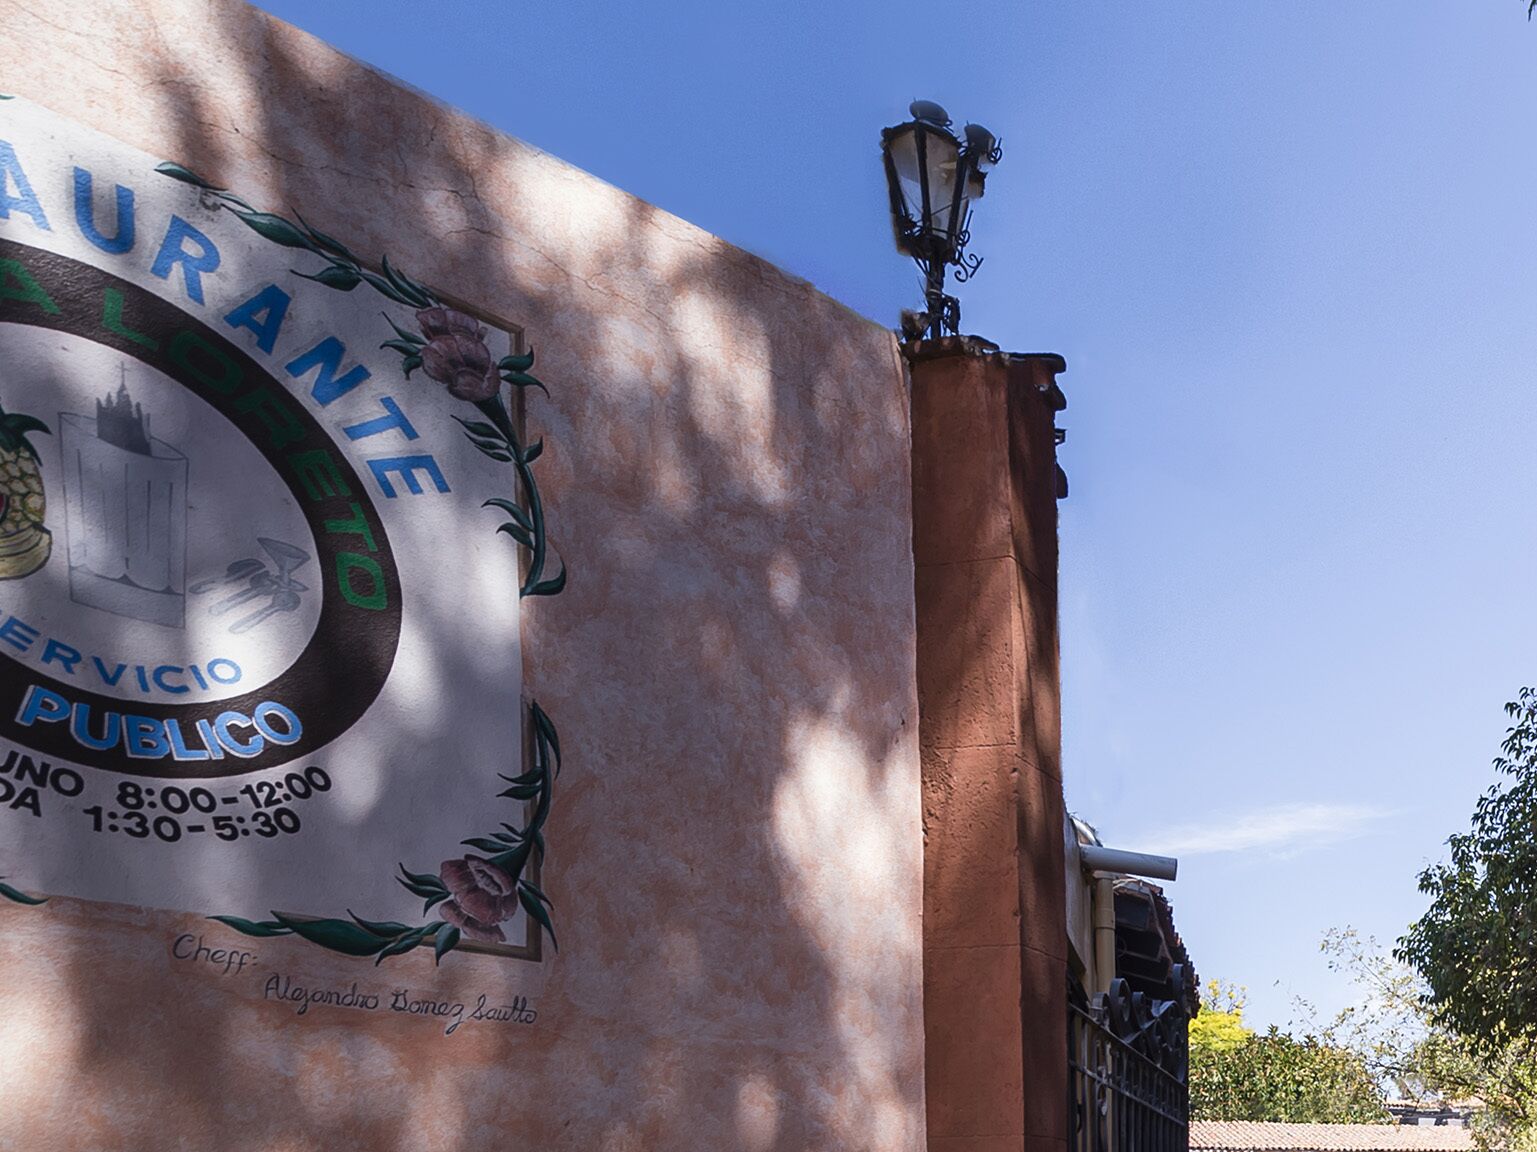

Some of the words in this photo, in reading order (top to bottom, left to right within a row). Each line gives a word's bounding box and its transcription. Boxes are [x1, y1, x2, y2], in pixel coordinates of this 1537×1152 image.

[0, 139, 450, 498] AURANTE
[101, 287, 388, 611] LORETO
[0, 615, 242, 694] ERVICIO
[14, 684, 303, 761] PUBLICO
[173, 934, 258, 975] Cheff:
